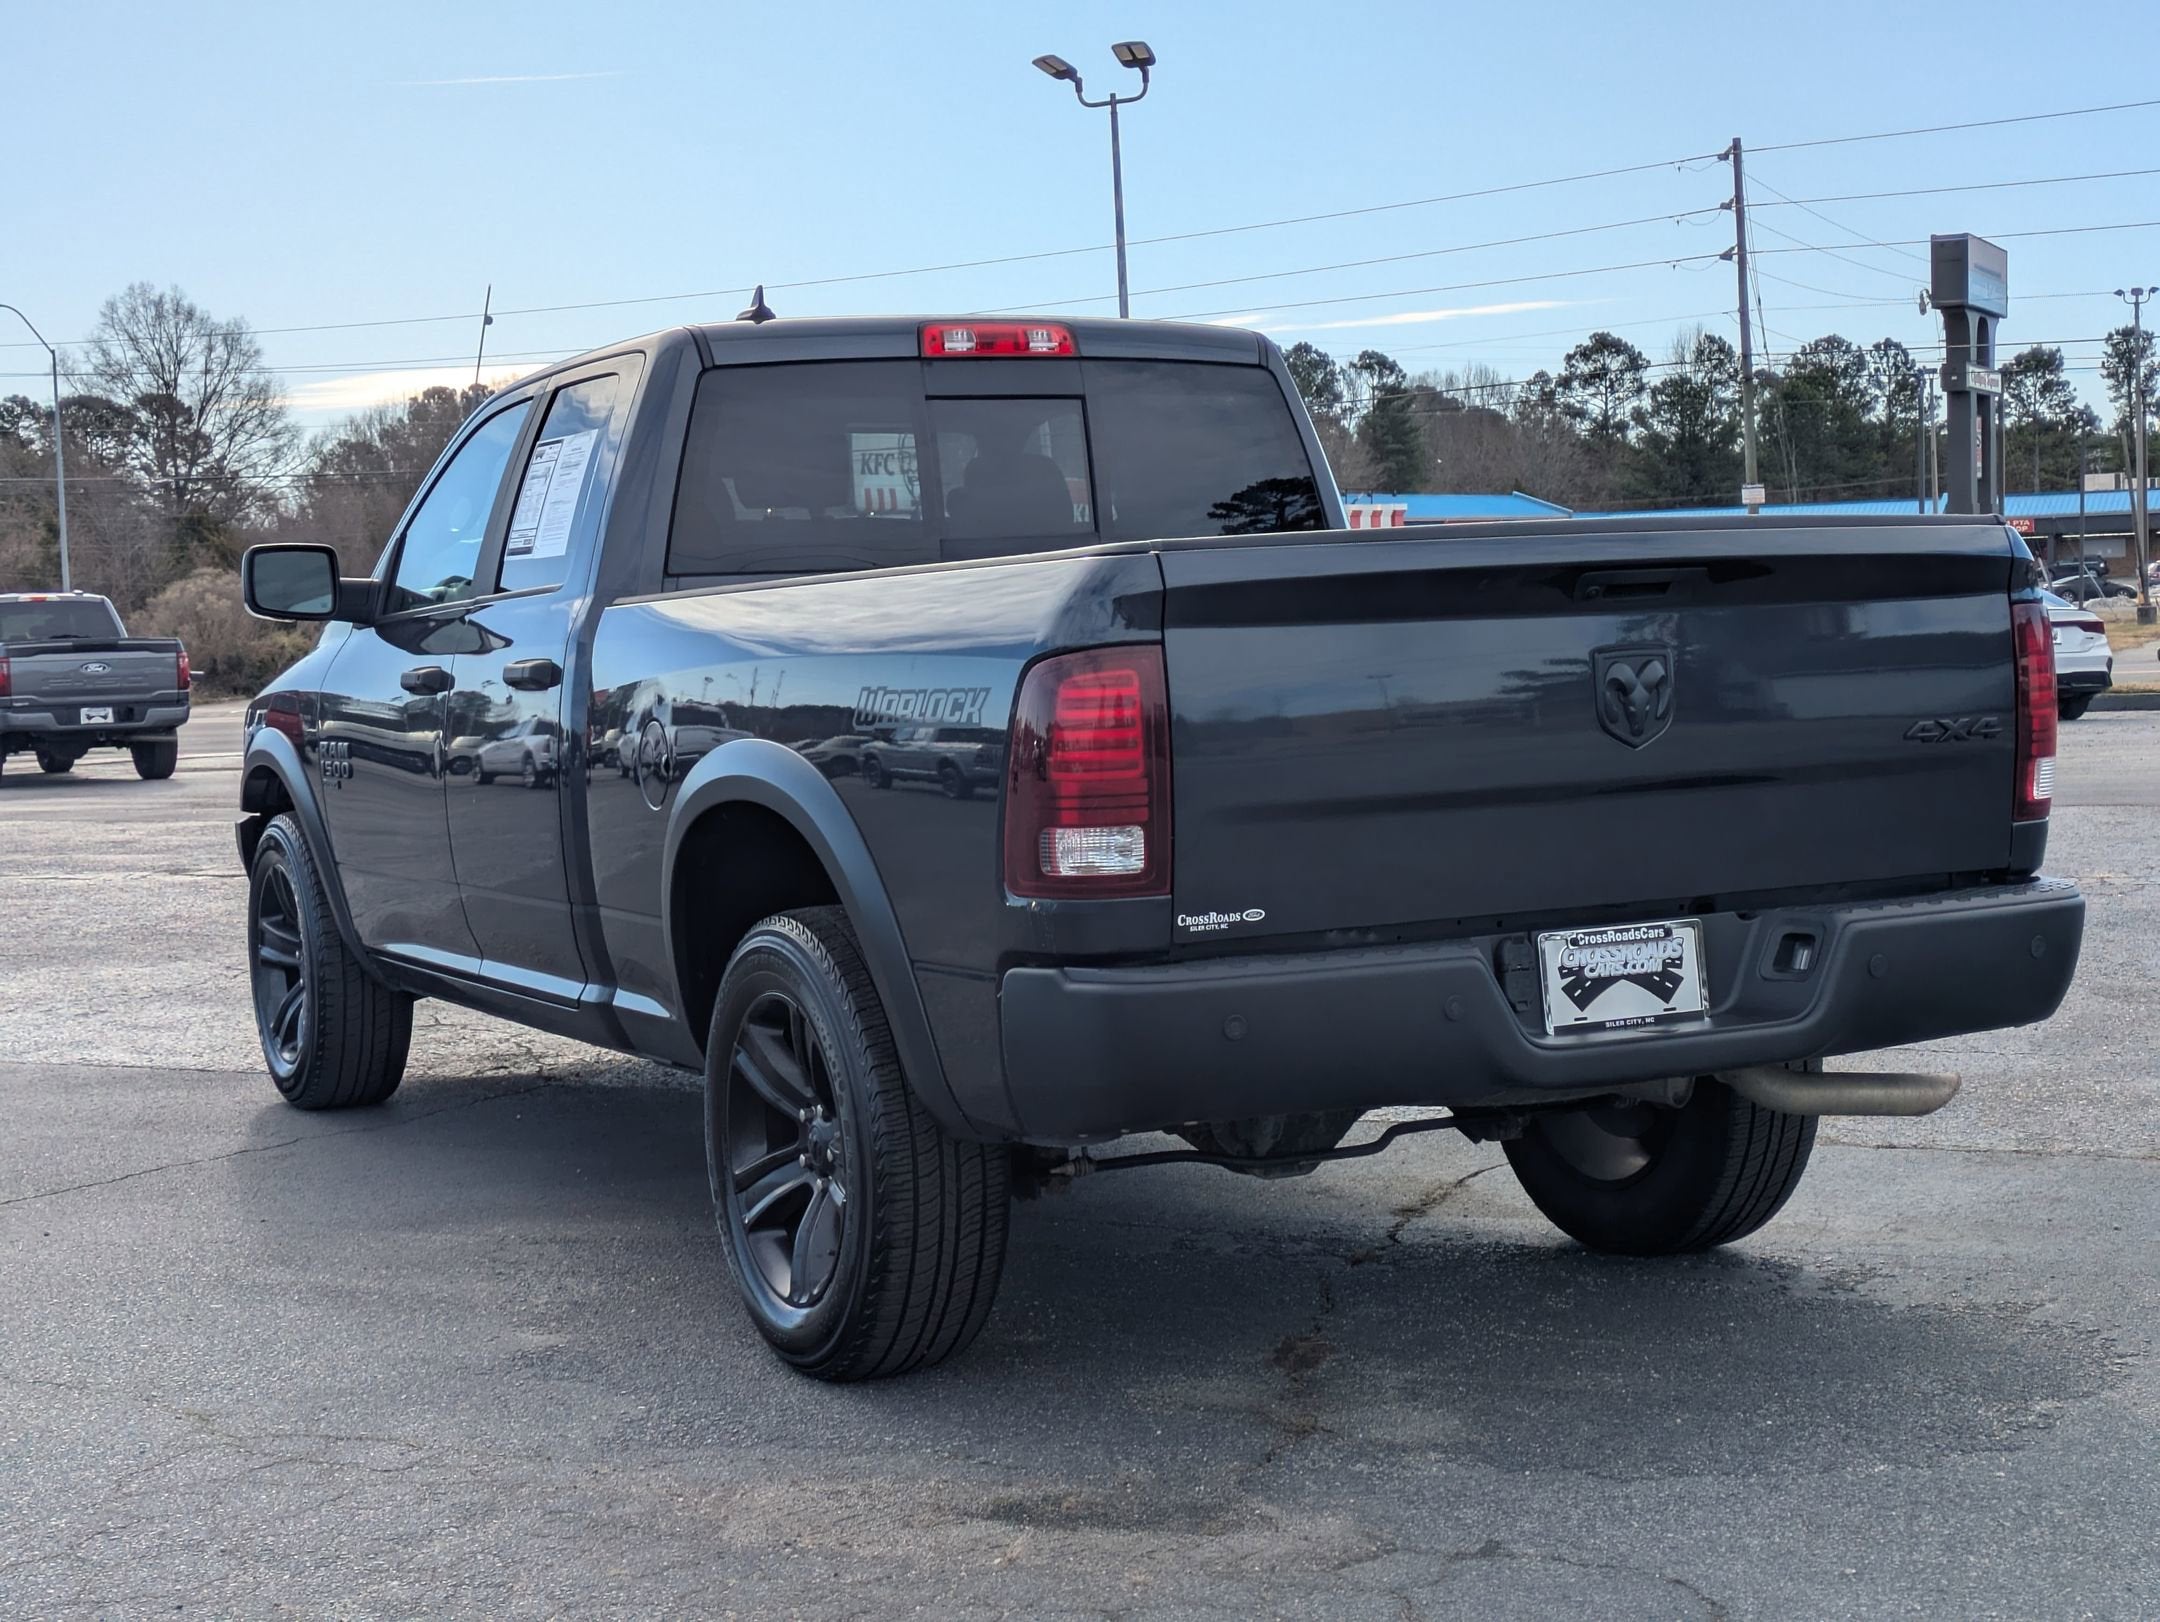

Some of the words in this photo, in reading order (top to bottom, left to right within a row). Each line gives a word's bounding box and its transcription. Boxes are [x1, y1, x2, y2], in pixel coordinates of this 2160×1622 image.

[861, 452, 896, 476] KFC
[319, 741, 350, 760] RAM
[320, 760, 350, 778] 1500
[1577, 927, 1665, 945] CrossRoadsCars
